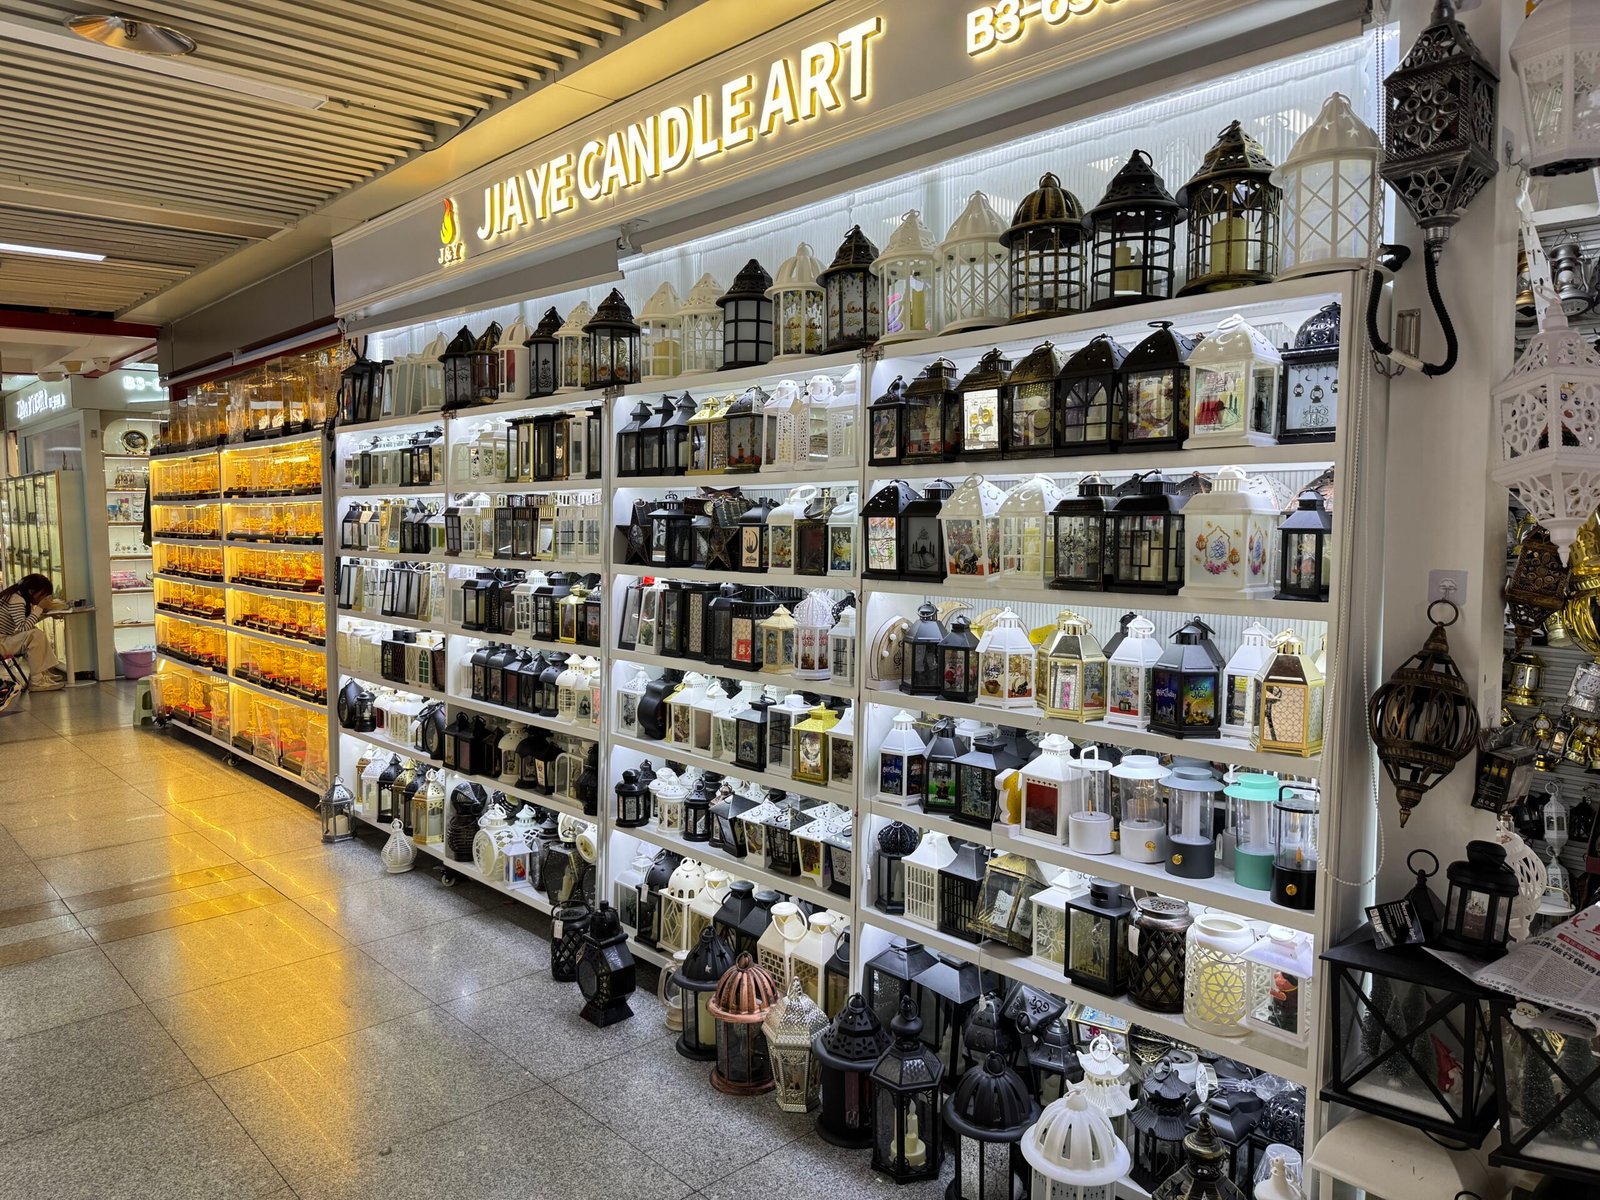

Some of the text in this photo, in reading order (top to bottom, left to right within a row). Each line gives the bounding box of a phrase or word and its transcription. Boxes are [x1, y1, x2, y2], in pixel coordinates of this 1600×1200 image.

[577, 75, 754, 200] CANDLE
[759, 16, 882, 136] ART
[438, 243, 463, 265] J&Y
